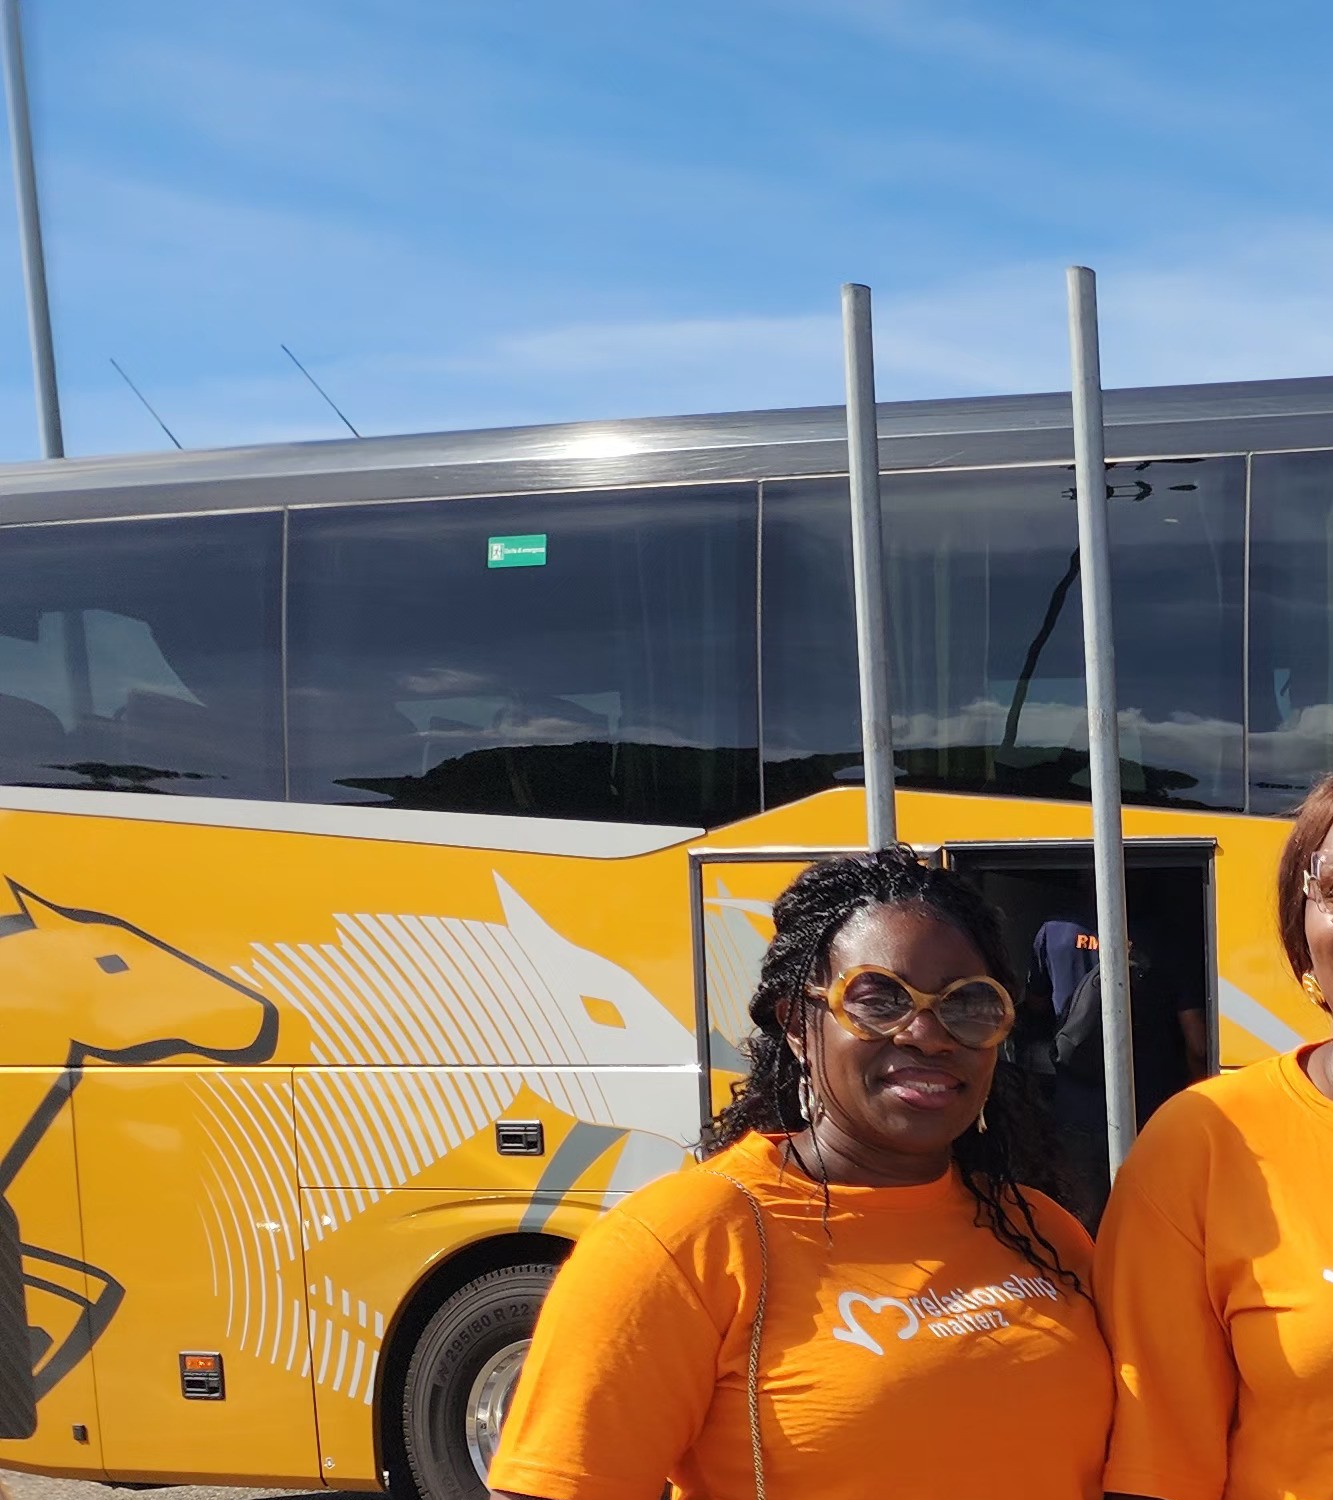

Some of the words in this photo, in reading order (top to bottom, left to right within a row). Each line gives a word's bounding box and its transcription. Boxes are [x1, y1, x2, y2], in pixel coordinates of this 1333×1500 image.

[908, 1273, 1058, 1320] relationship
[445, 1314, 492, 1363] 295/80
[927, 1310, 1010, 1338] matterz
